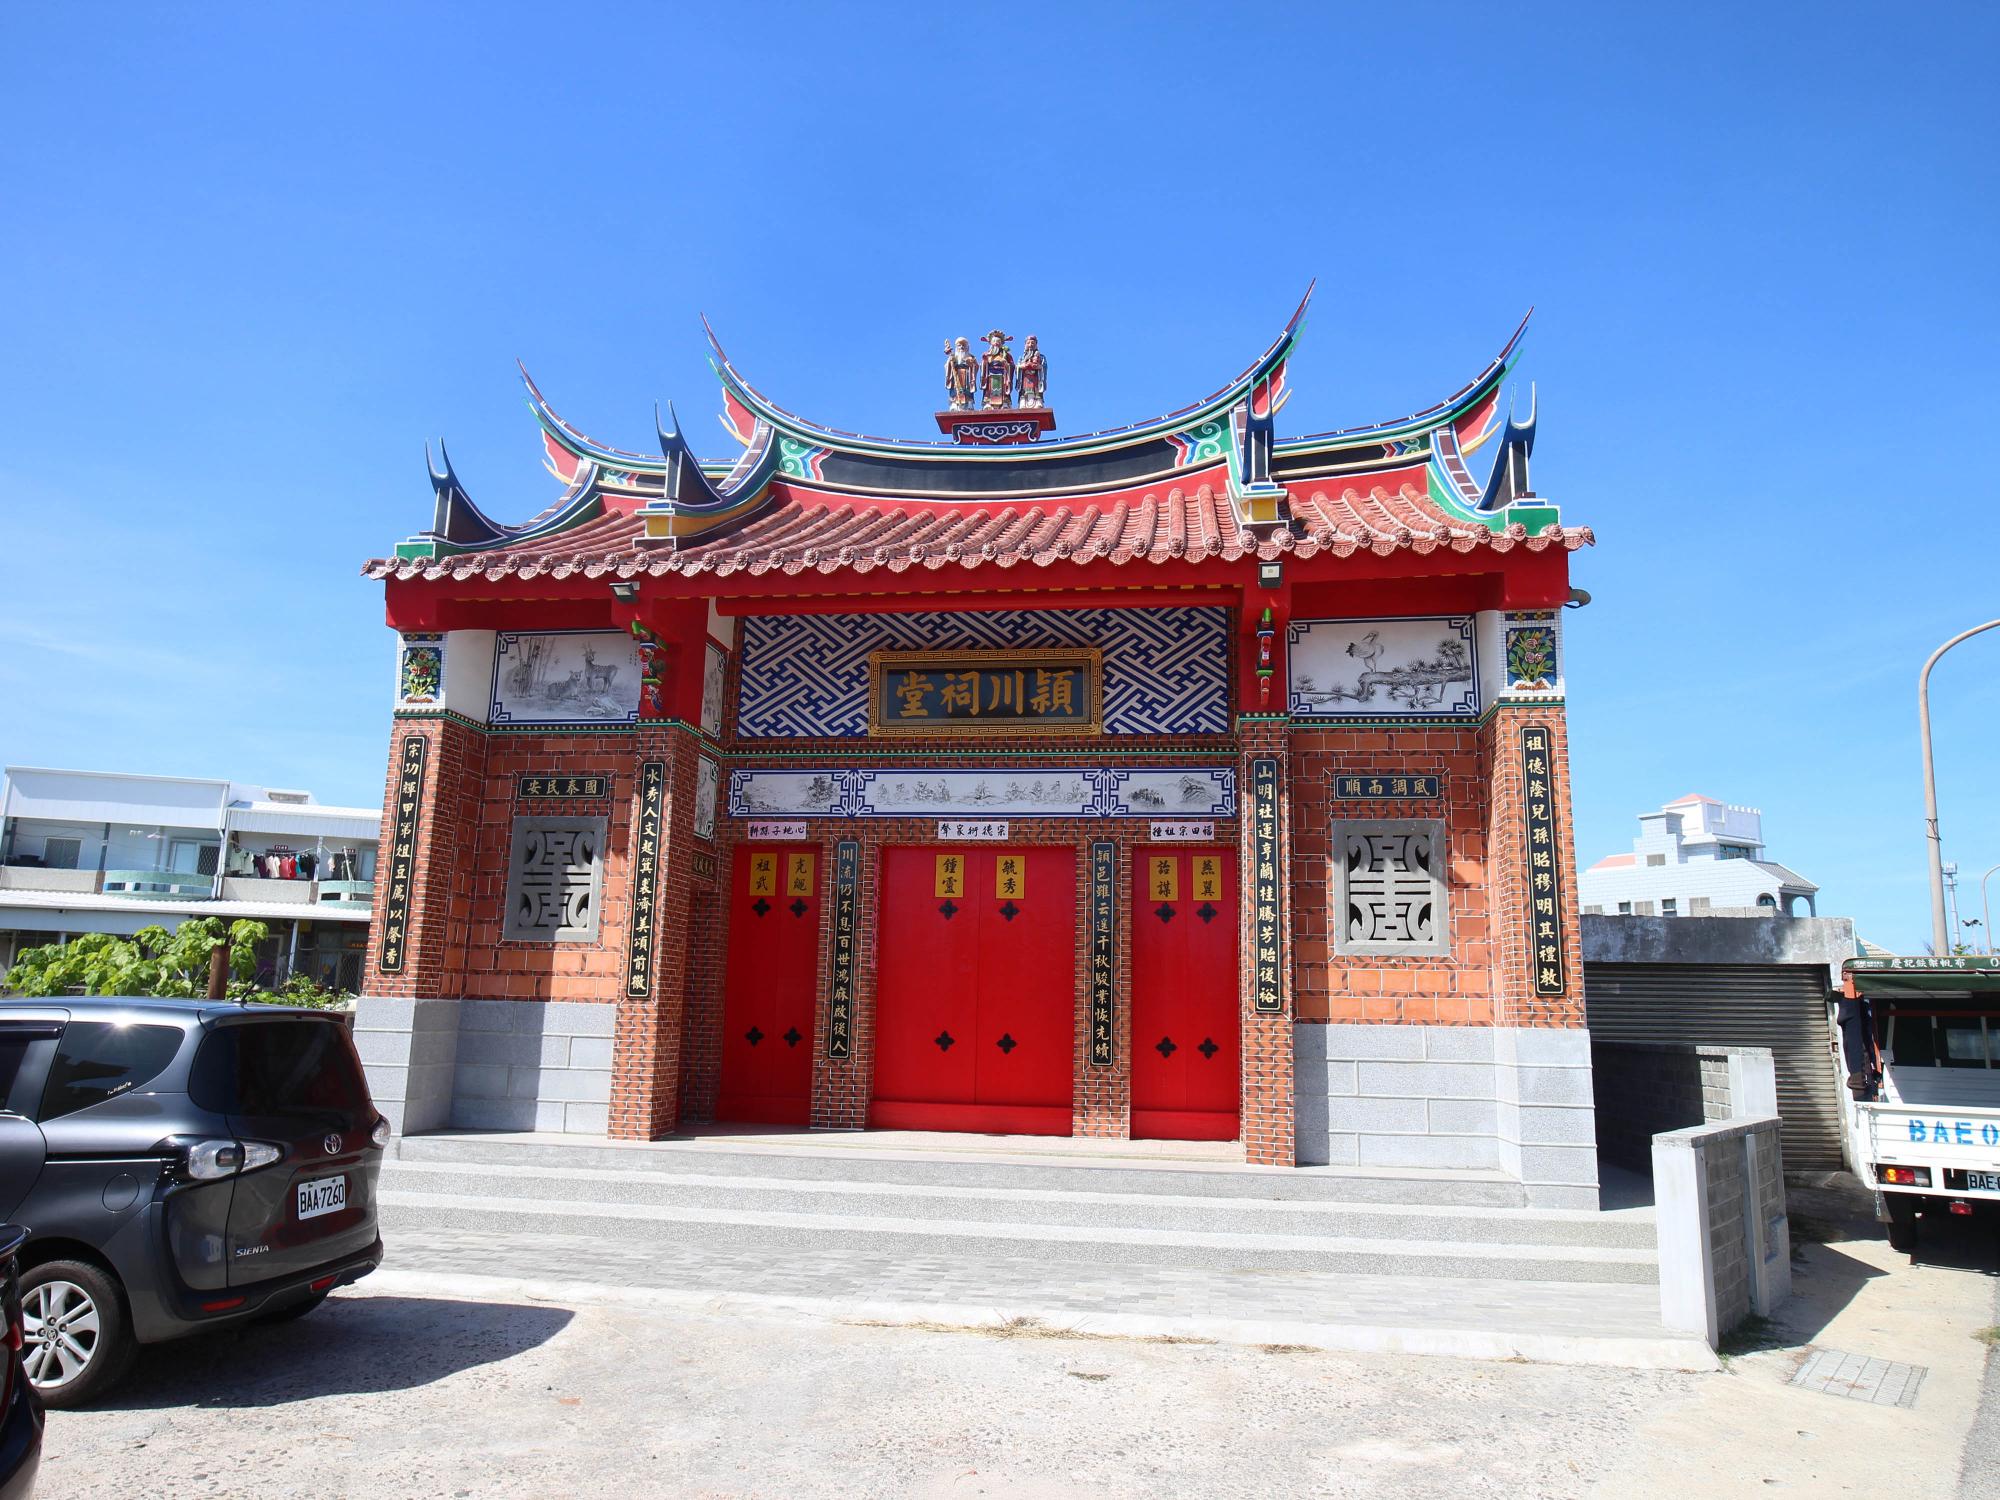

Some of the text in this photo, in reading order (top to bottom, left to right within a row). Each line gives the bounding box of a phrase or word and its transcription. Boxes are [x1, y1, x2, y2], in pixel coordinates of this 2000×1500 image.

[527, 779, 598, 796] 國泰民安
[1345, 778, 1430, 796] 風調雨順
[236, 1245, 269, 1257] SIENTA
